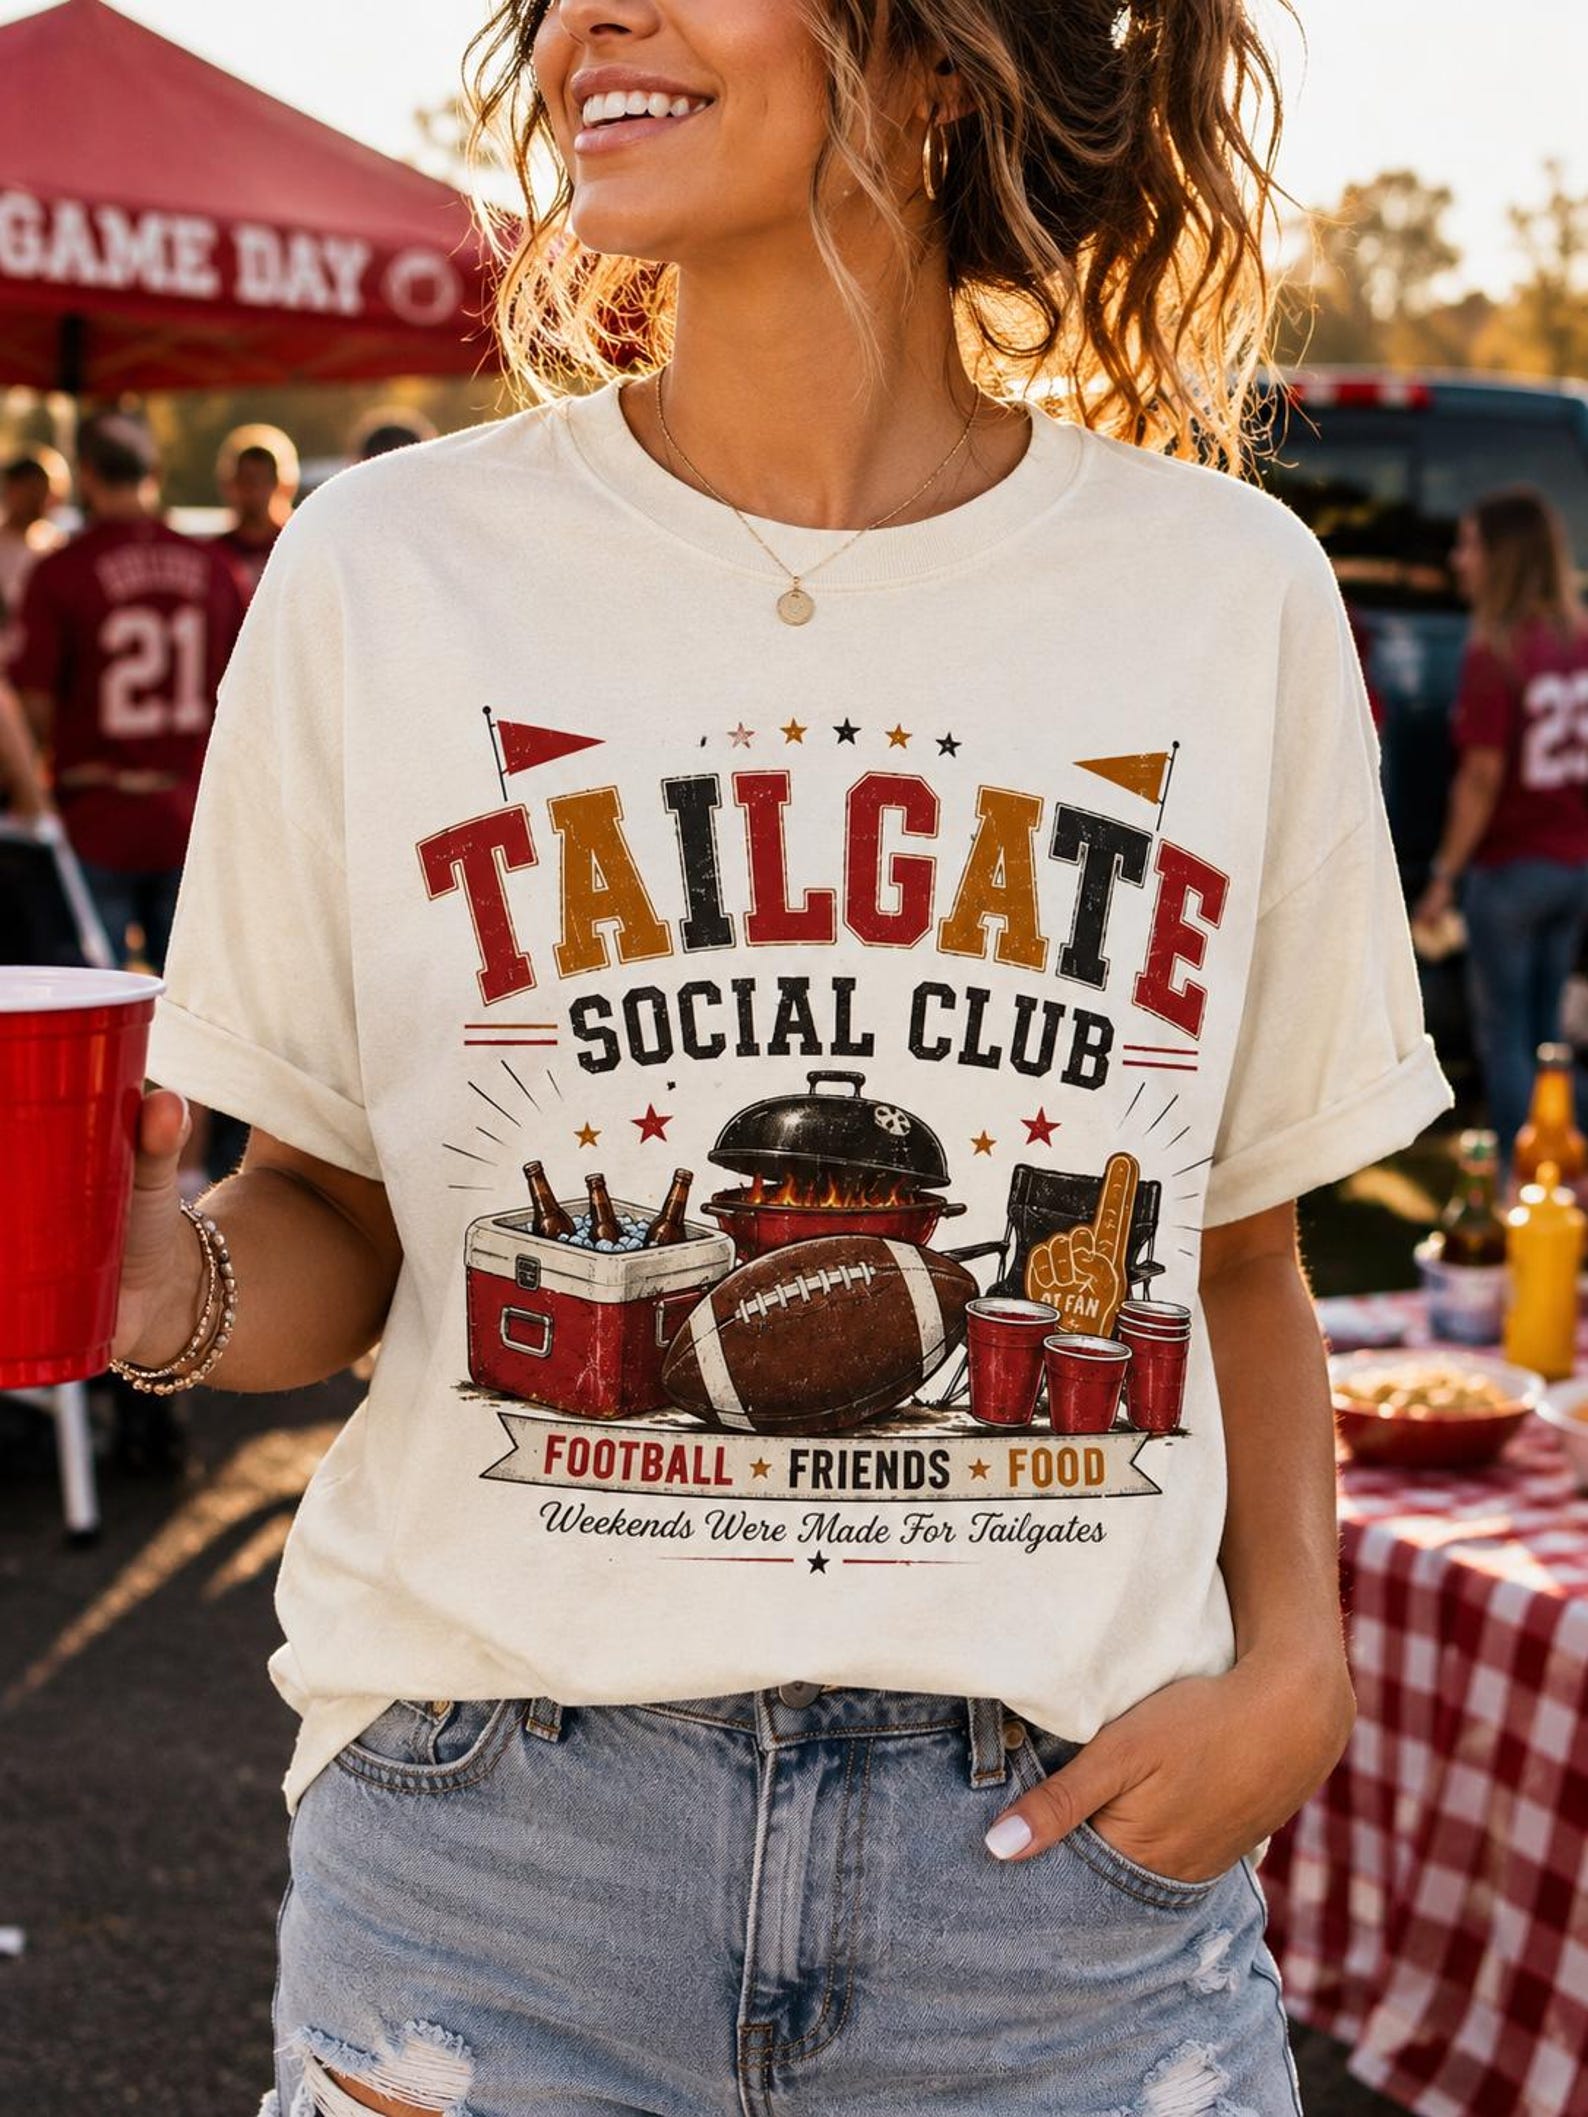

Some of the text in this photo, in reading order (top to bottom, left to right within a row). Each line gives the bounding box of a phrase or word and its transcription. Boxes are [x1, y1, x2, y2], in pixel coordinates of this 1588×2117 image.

[0, 191, 370, 315] GAME DAY
[100, 607, 205, 734] 21
[414, 769, 1232, 1041] TAILGATE
[568, 977, 1114, 1091] SOCIAL CLUB
[1065, 1294, 1100, 1318] FAN
[543, 1434, 1106, 1491] FOOTBALL FRIENDS FOOD
[539, 1501, 1107, 1554] Weekends Were Made For Tailgates
